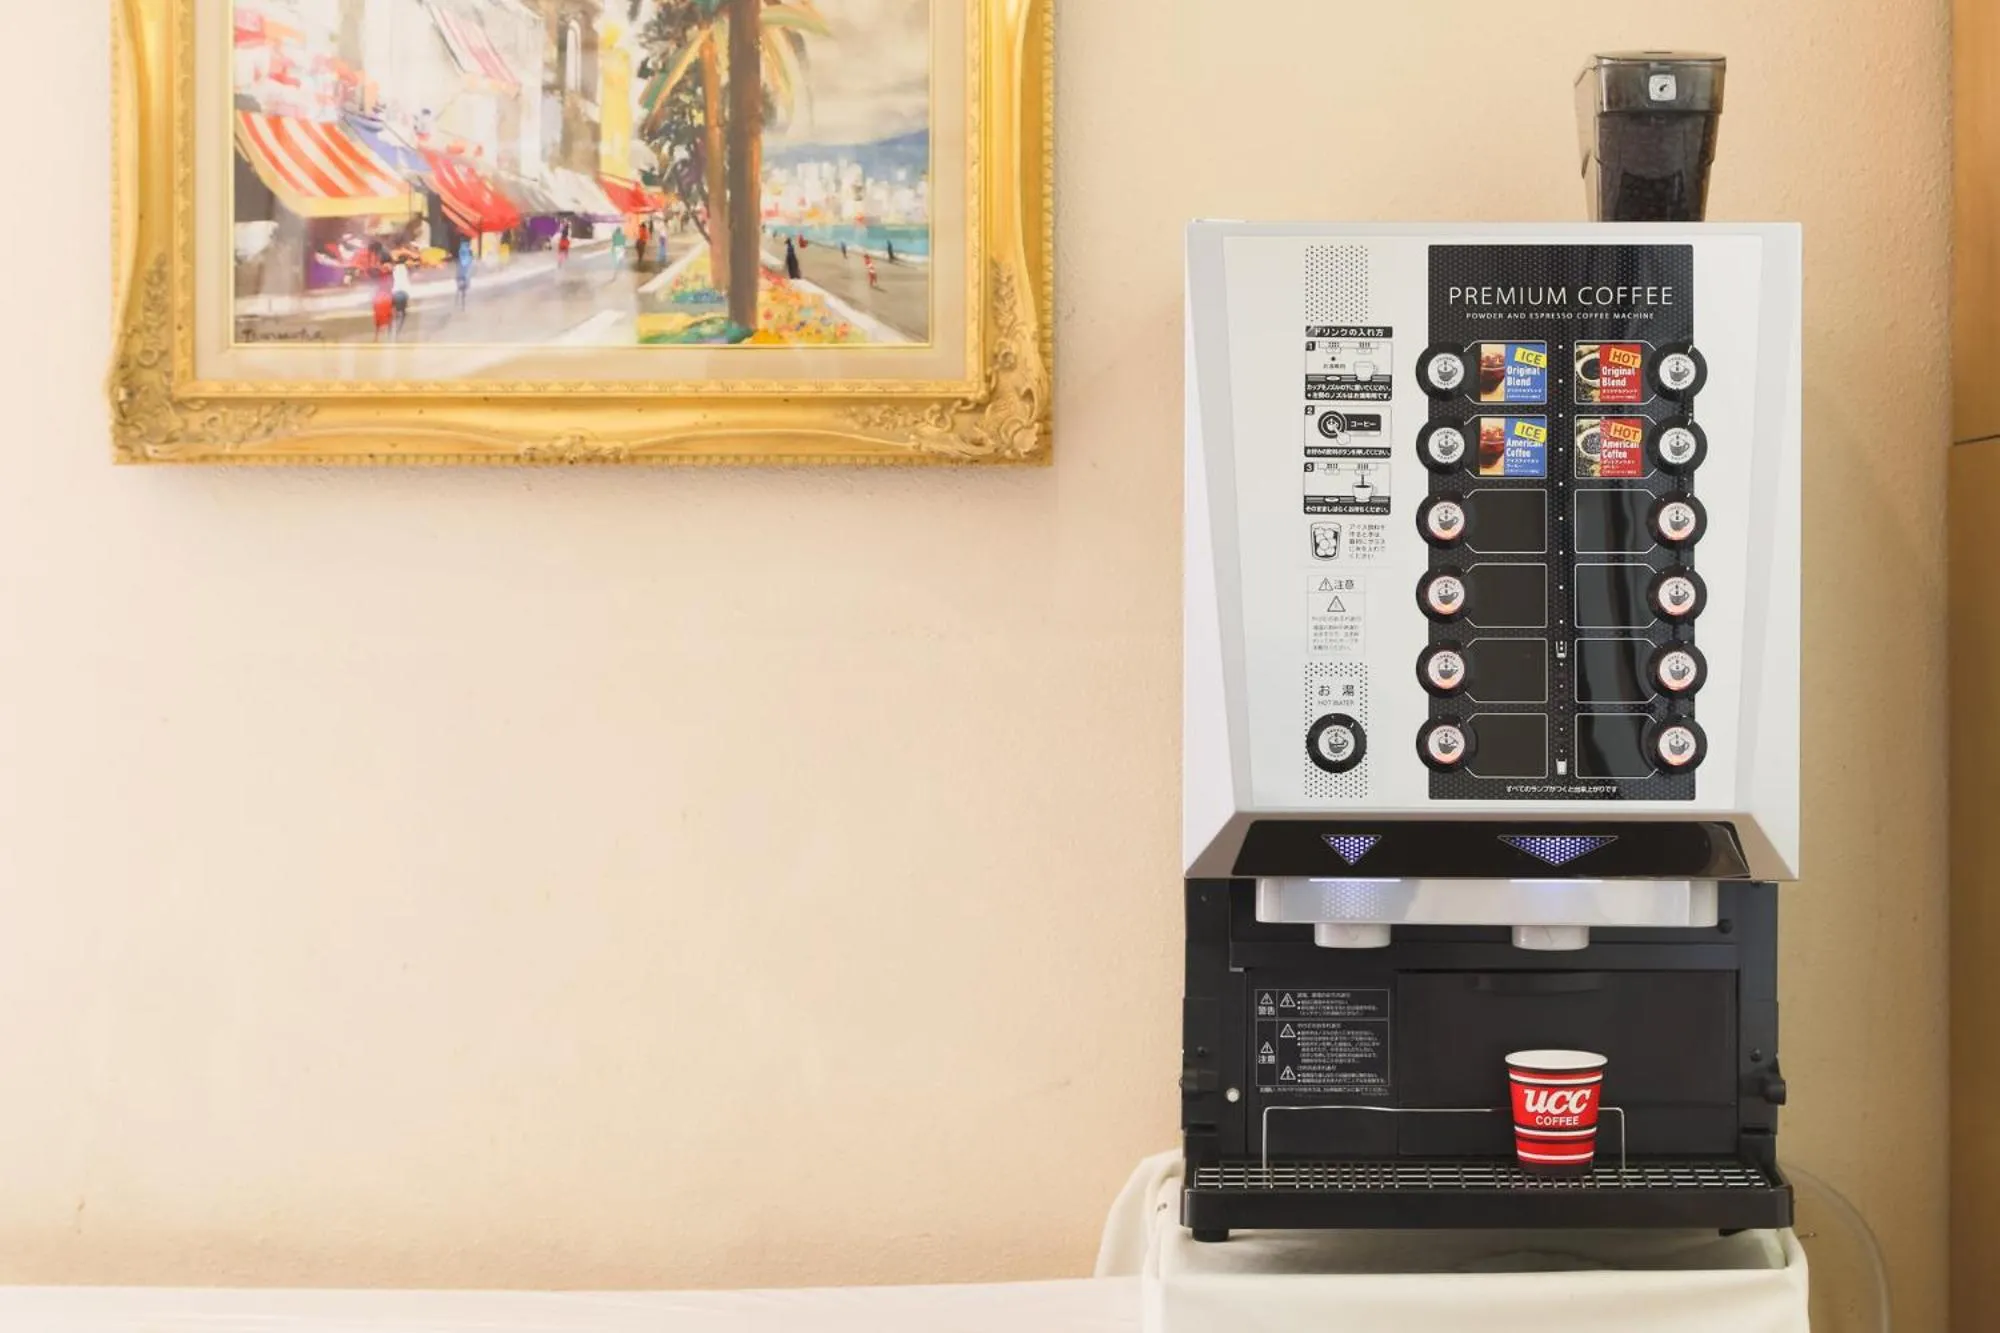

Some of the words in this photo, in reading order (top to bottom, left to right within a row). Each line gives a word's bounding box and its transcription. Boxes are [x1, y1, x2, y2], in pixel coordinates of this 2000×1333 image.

[1449, 286, 1567, 305] PREMIUM
[1577, 286, 1674, 305] COFFEE
[1466, 312, 1504, 320] POWDER
[1506, 312, 1526, 320] AND
[1529, 312, 1573, 320] ESPRESSO
[1576, 312, 1609, 320] COFFEE
[1613, 312, 1654, 320] MACHINE
[1315, 327, 1384, 337] ドリンクの入れ方
[1521, 351, 1543, 365] ICE
[1612, 351, 1639, 365] HOT
[1507, 366, 1540, 376] Original
[1602, 366, 1635, 377] Original
[1507, 377, 1531, 386] Blend
[1602, 377, 1626, 387] Blend
[1350, 420, 1377, 428] コーヒー
[1521, 425, 1542, 439] ICE
[1613, 426, 1640, 441] HOT
[1602, 439, 1640, 449] American
[1506, 448, 1531, 457] Coffee
[1602, 449, 1627, 458] Coffee
[1335, 579, 1354, 590] 注意
[1506, 785, 1617, 793] すべてのランプがつくと出来上がりです
[1535, 1116, 1580, 1126] COFFEE
